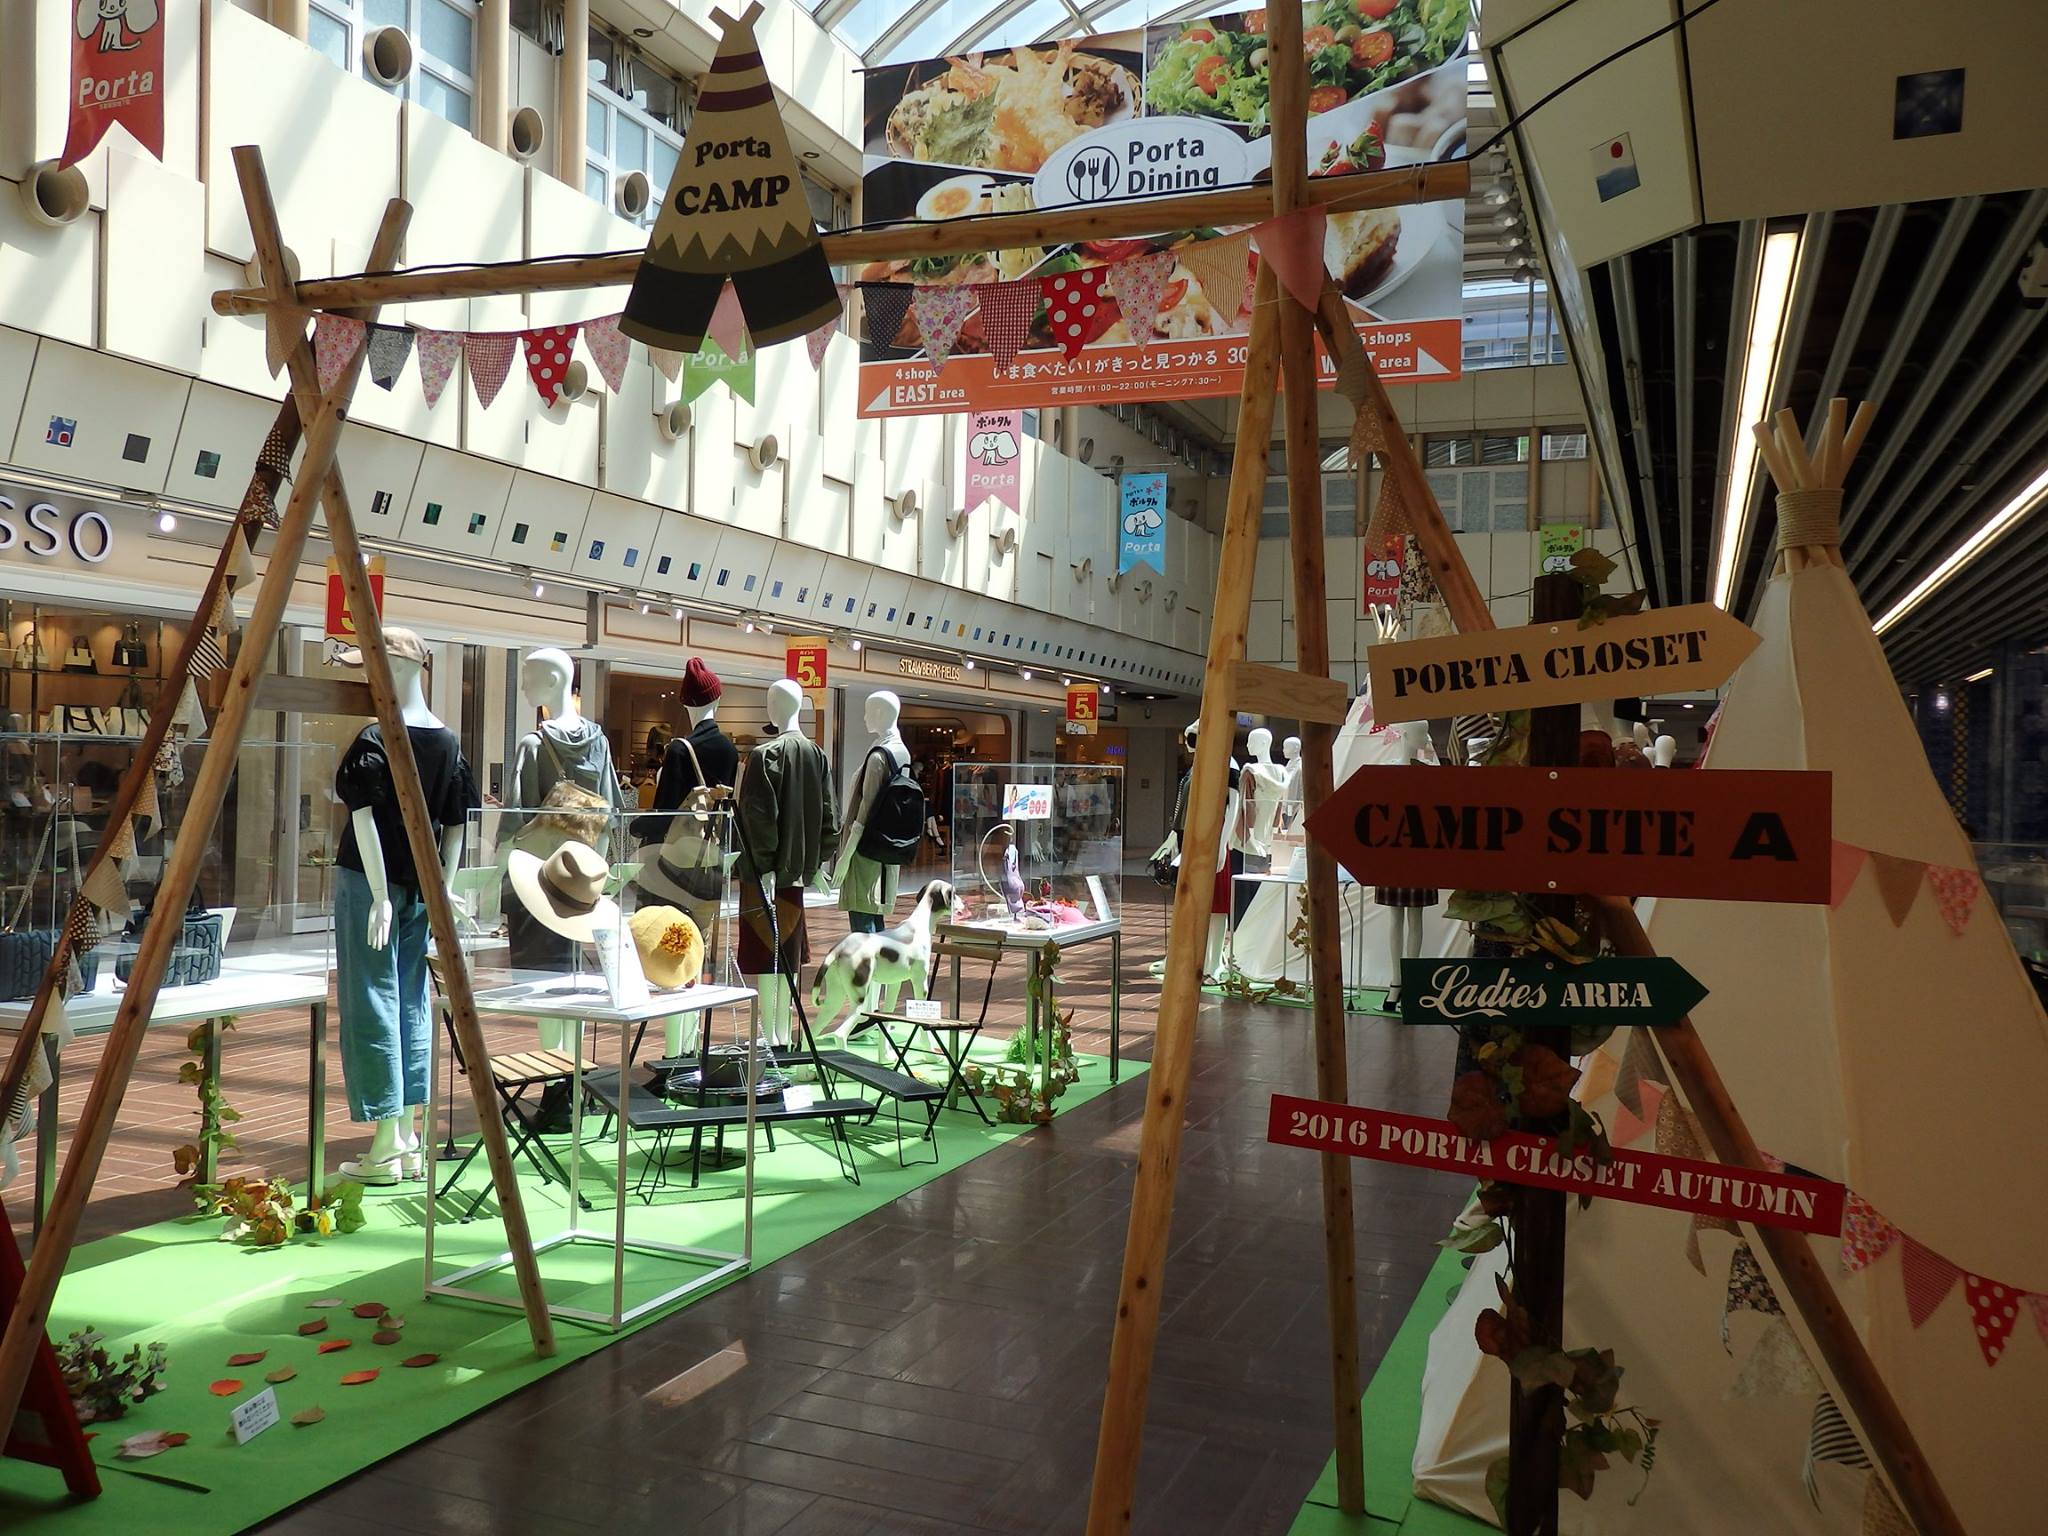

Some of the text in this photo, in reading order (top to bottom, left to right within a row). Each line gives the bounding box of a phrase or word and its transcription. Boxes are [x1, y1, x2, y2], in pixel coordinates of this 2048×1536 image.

[78, 70, 154, 106] Porta
[695, 136, 772, 168] Porta
[1128, 137, 1205, 165] Porta
[1127, 164, 1219, 195] Dining
[674, 175, 790, 216] CAMP
[1369, 331, 1412, 347] shops
[895, 367, 938, 382] 4 shops
[1379, 356, 1412, 369] area
[895, 383, 966, 404] EAST area
[970, 473, 1015, 487] Porta
[1125, 541, 1161, 552] Porta
[1392, 630, 1708, 697] PORTA CLOSET
[1354, 803, 1799, 861] CAMP SITE A
[1419, 964, 1653, 1019] Ladies AREA
[1289, 1111, 1818, 1219] 2016 PORTA CLOSET AUTUMN
